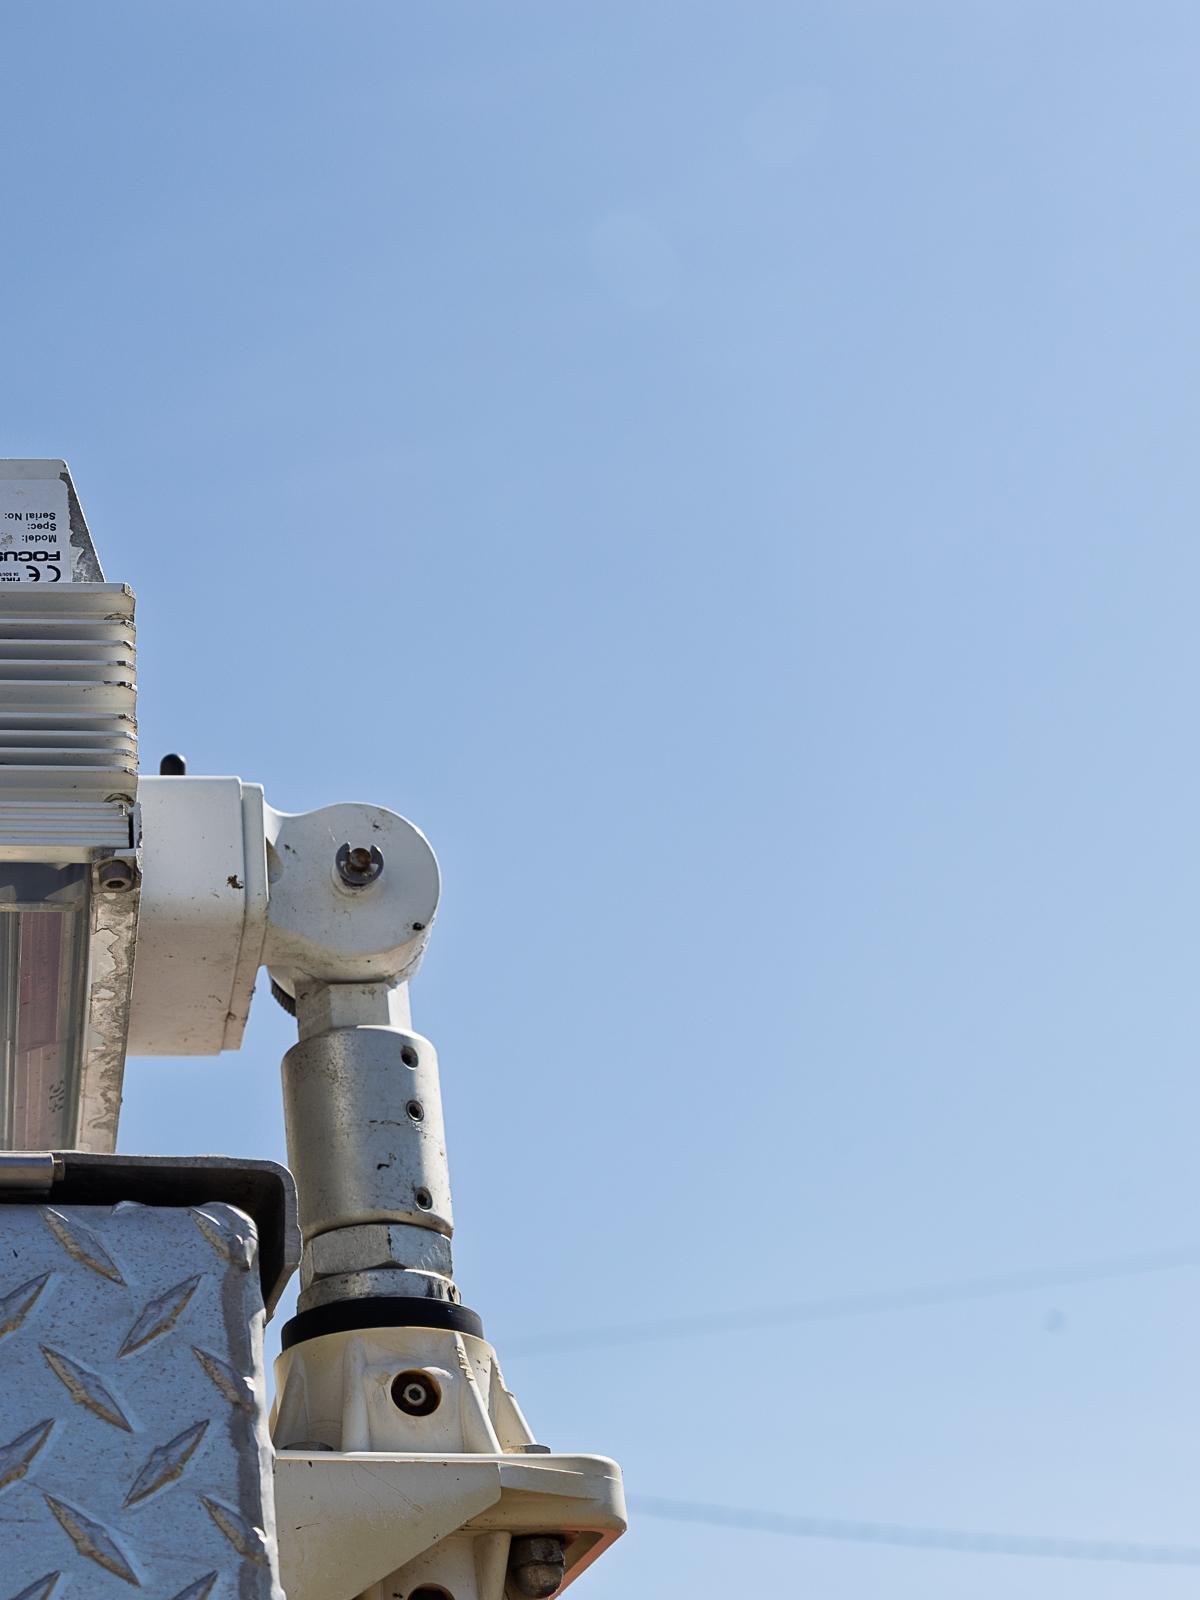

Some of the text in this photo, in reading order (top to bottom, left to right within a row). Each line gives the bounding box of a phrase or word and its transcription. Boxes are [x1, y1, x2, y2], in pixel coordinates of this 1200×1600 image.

[4, 512, 23, 522] No:
[25, 512, 56, 522] Serial
[27, 521, 57, 533] Spec:
[21, 534, 57, 545] Model:
